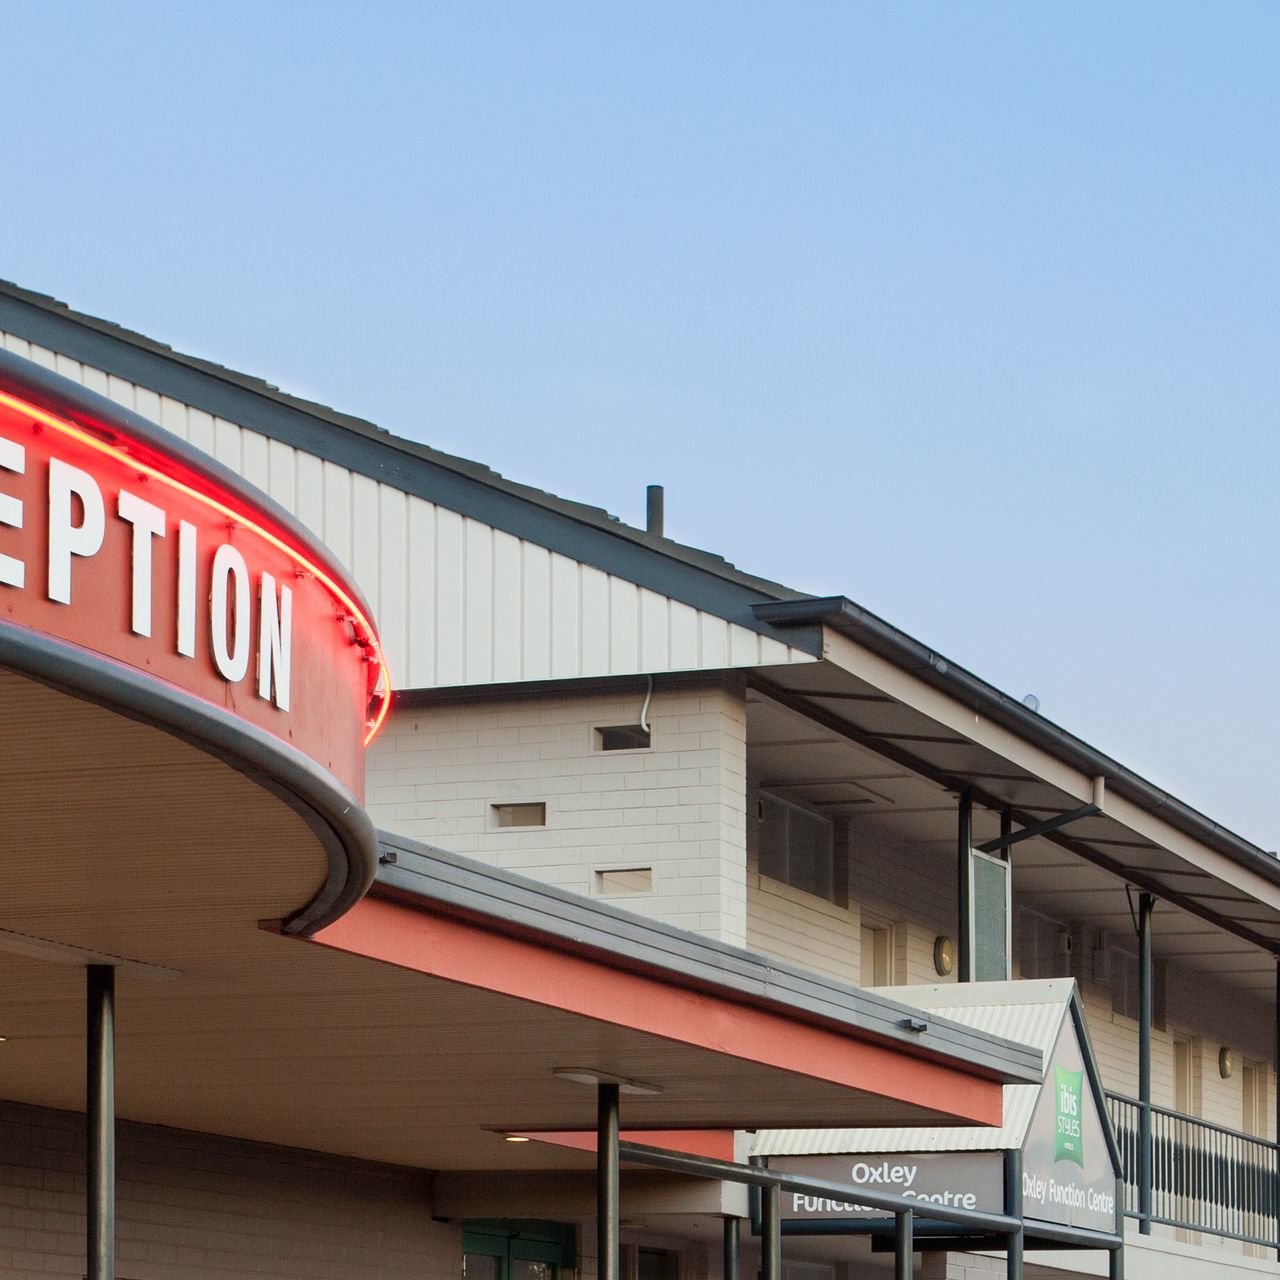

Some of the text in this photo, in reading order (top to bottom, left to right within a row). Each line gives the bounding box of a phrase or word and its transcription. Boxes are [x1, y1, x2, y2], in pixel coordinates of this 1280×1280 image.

[1061, 1083, 1077, 1116] ibis
[1057, 1116, 1081, 1137] STYLES
[851, 1162, 918, 1187] Oxley
[1022, 1172, 1114, 1215] Oxley Function Centre
